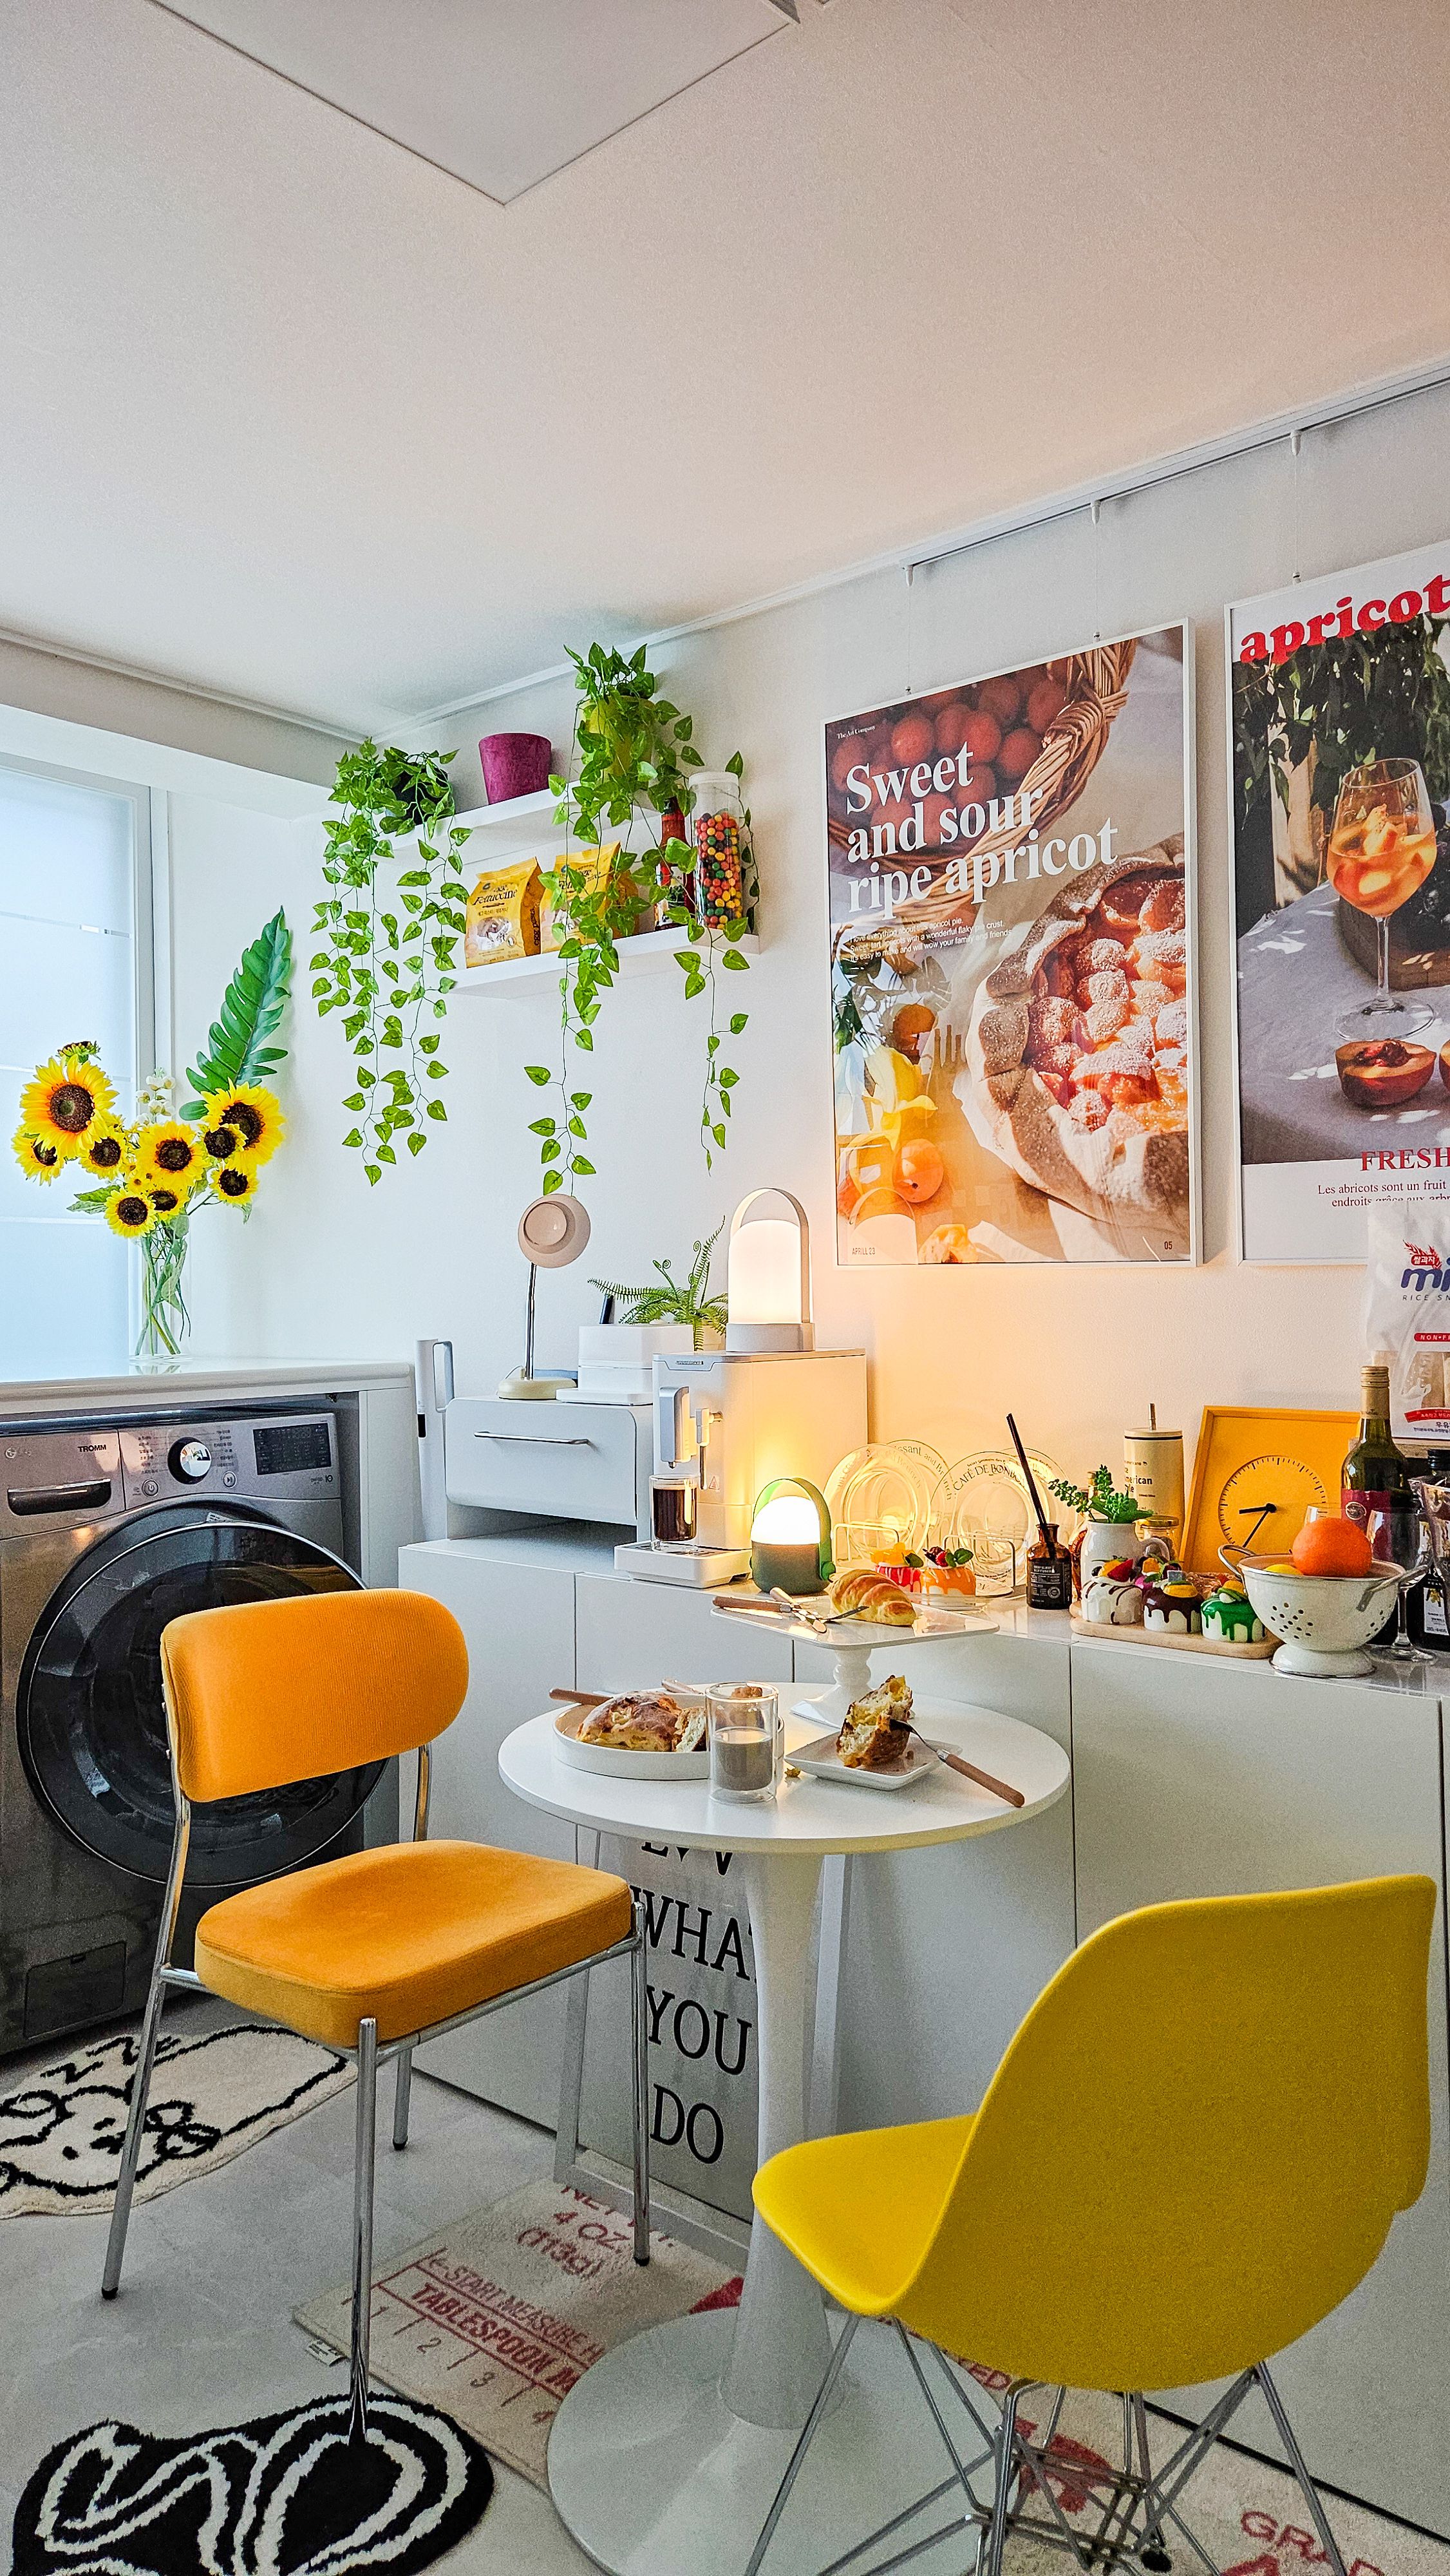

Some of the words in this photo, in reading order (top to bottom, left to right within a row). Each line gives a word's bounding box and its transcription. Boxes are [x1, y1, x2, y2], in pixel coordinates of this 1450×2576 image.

[847, 741, 974, 815] Sweet
[847, 801, 927, 863] and
[939, 788, 1044, 846] sour
[848, 862, 932, 921] ripe
[945, 818, 1119, 905] apricot
[867, 929, 897, 941] everything
[899, 926, 916, 934] about
[929, 920, 951, 931] apricot
[952, 917, 964, 926] pie.
[907, 933, 919, 942] with
[926, 926, 957, 940] wonderful
[959, 925, 974, 934] flaky
[860, 951, 874, 960] easy
[882, 947, 899, 956] make
[900, 944, 912, 953] and
[913, 941, 923, 951] will
[924, 940, 939, 949] wow
[939, 938, 954, 949] your
[955, 934, 974, 944] family
[1360, 1147, 1450, 1171] FRESH
[1318, 1184, 1335, 1195] Les
[1339, 1182, 1379, 1194] abricots
[1382, 1182, 1404, 1192] sont
[1407, 1183, 1420, 1191] un
[1424, 1179, 1447, 1190] fruit
[1332, 1196, 1373, 1208] endroits
[1164, 1241, 1172, 1250] 05
[1413, 1256, 1436, 1265] 쌀과자
[953, 1468, 975, 1490] CAFÉ
[975, 1464, 989, 1476] DE
[646, 1984, 752, 2075] YOU
[650, 2083, 724, 2164] DO
[410, 2281, 559, 2374] TABLESPOON
[417, 2336, 442, 2354] 2
[469, 2371, 495, 2388] 3
